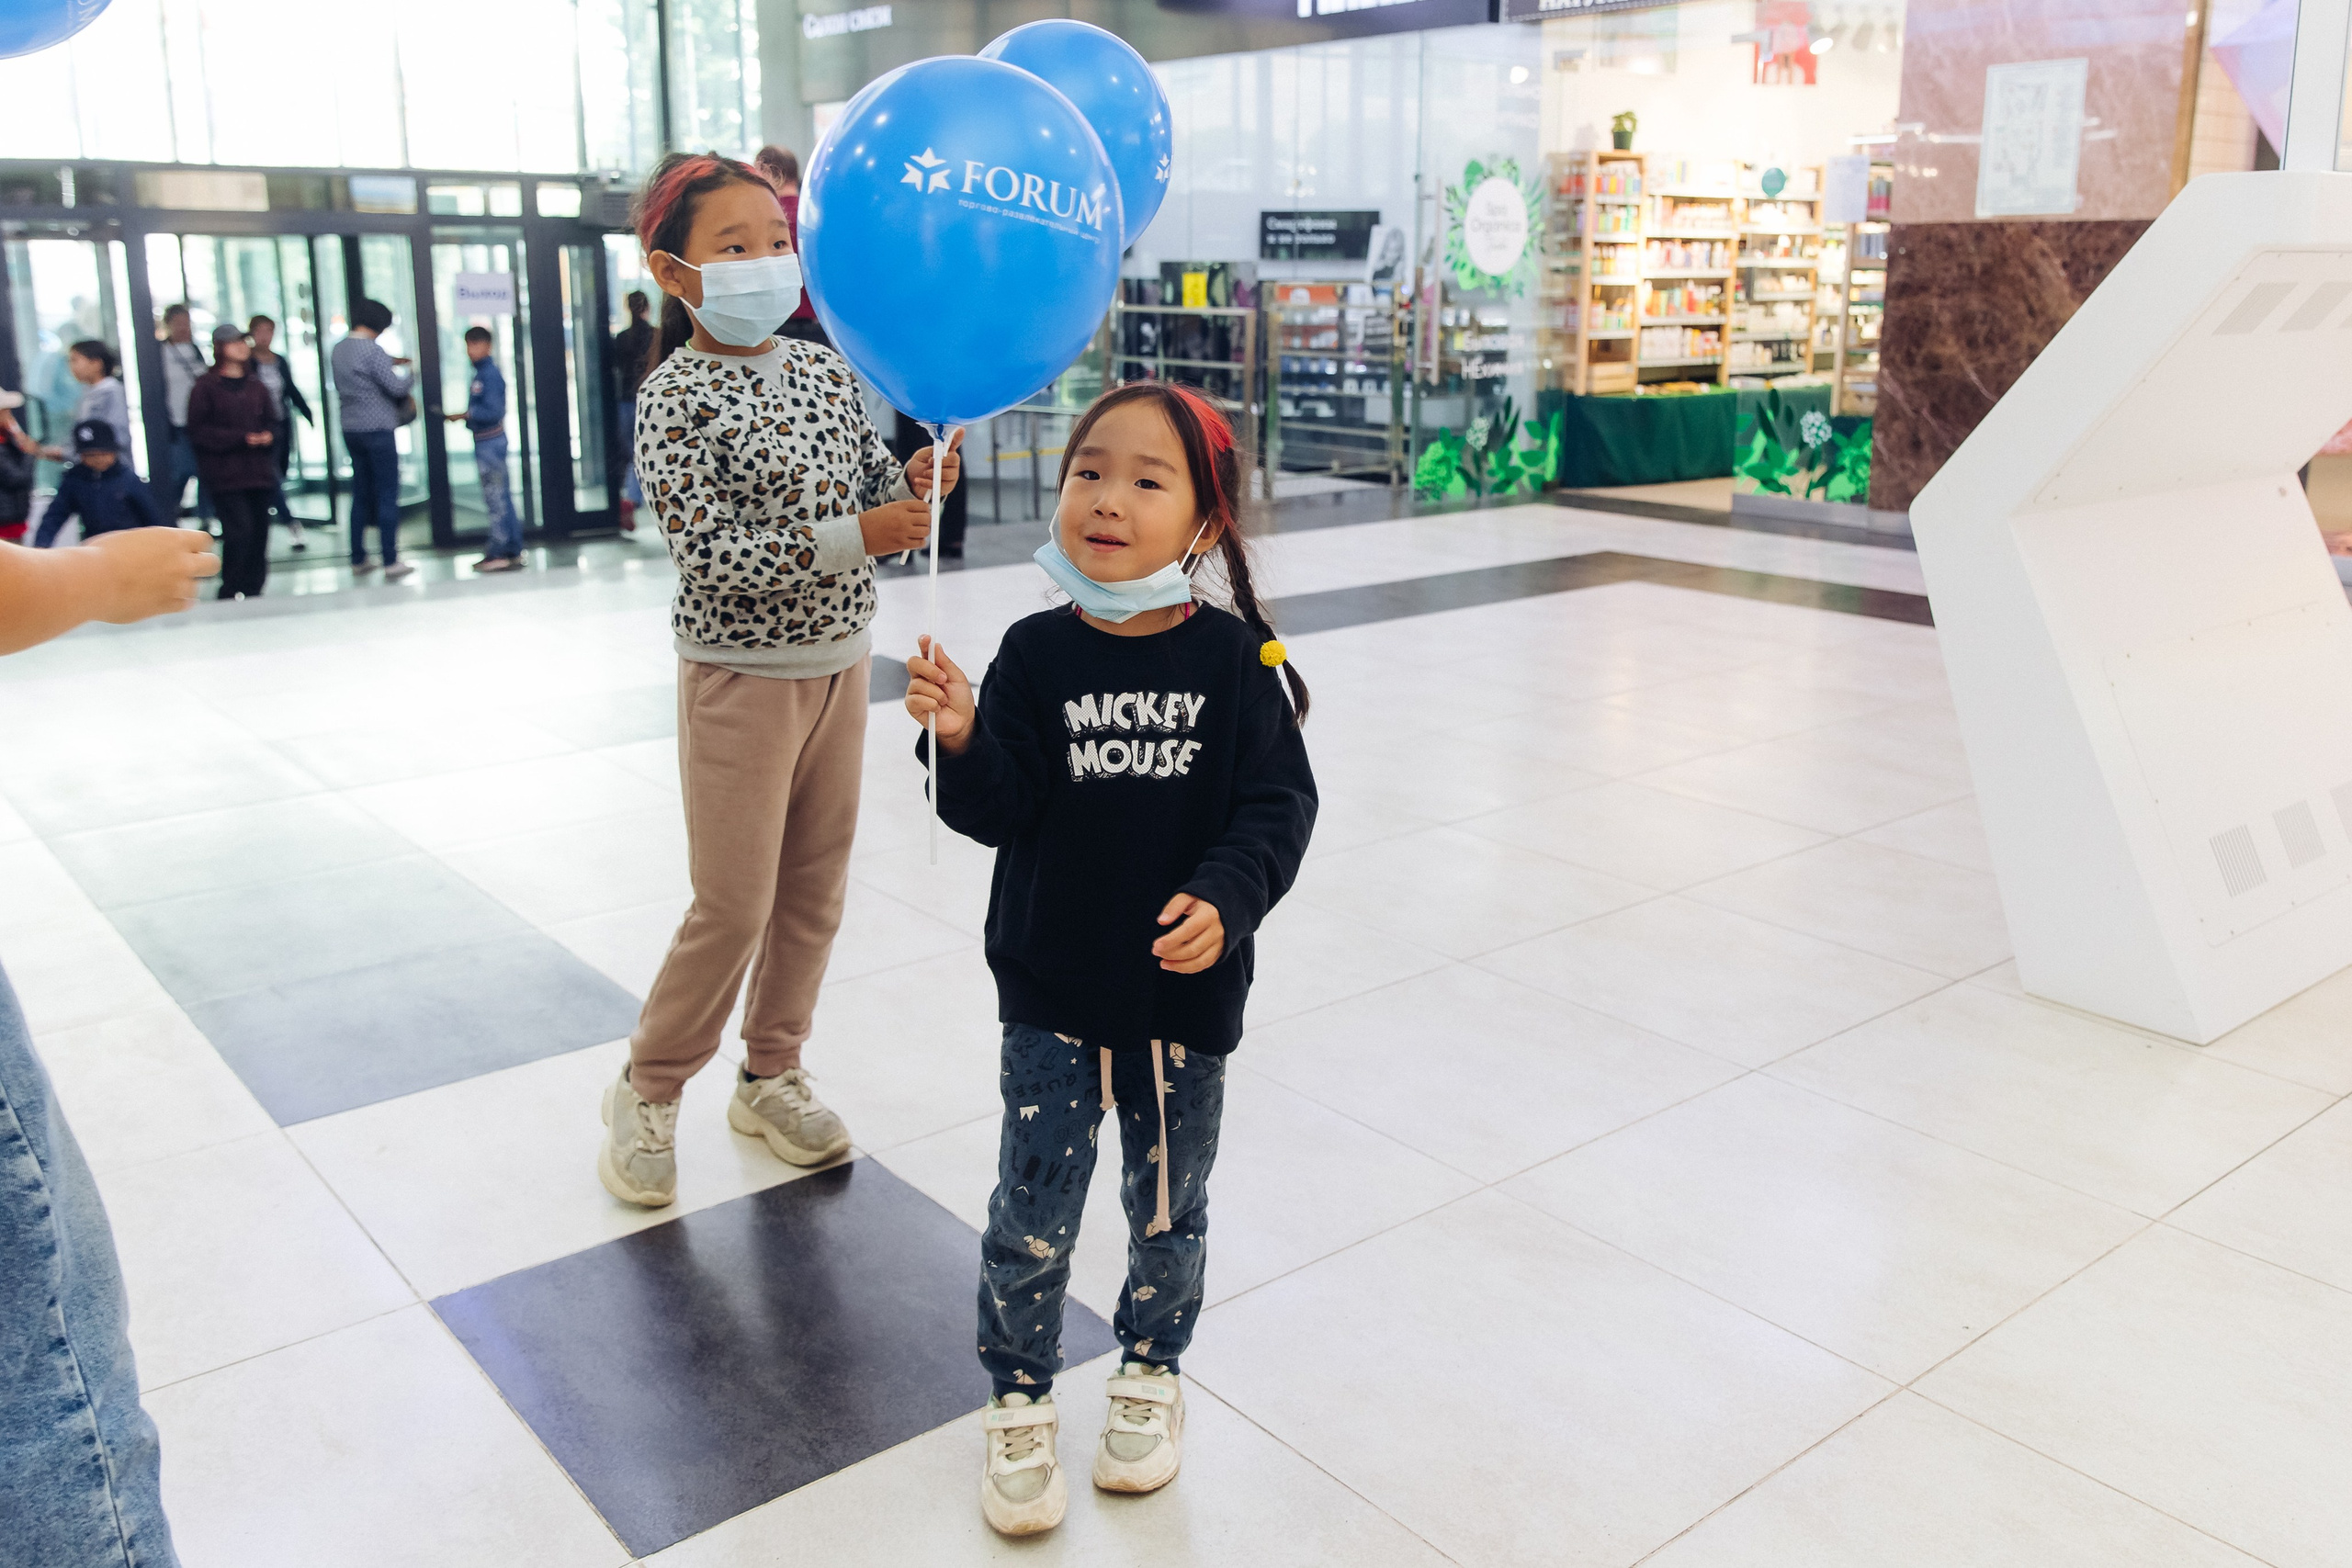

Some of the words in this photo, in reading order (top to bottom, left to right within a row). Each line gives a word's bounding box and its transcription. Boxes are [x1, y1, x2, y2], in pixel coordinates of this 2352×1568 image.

[960, 160, 1102, 231] FORUM
[1063, 690, 1206, 738] MICKEY
[1067, 739, 1203, 782] MOUSE
[1012, 1145, 1079, 1194] LOVE
